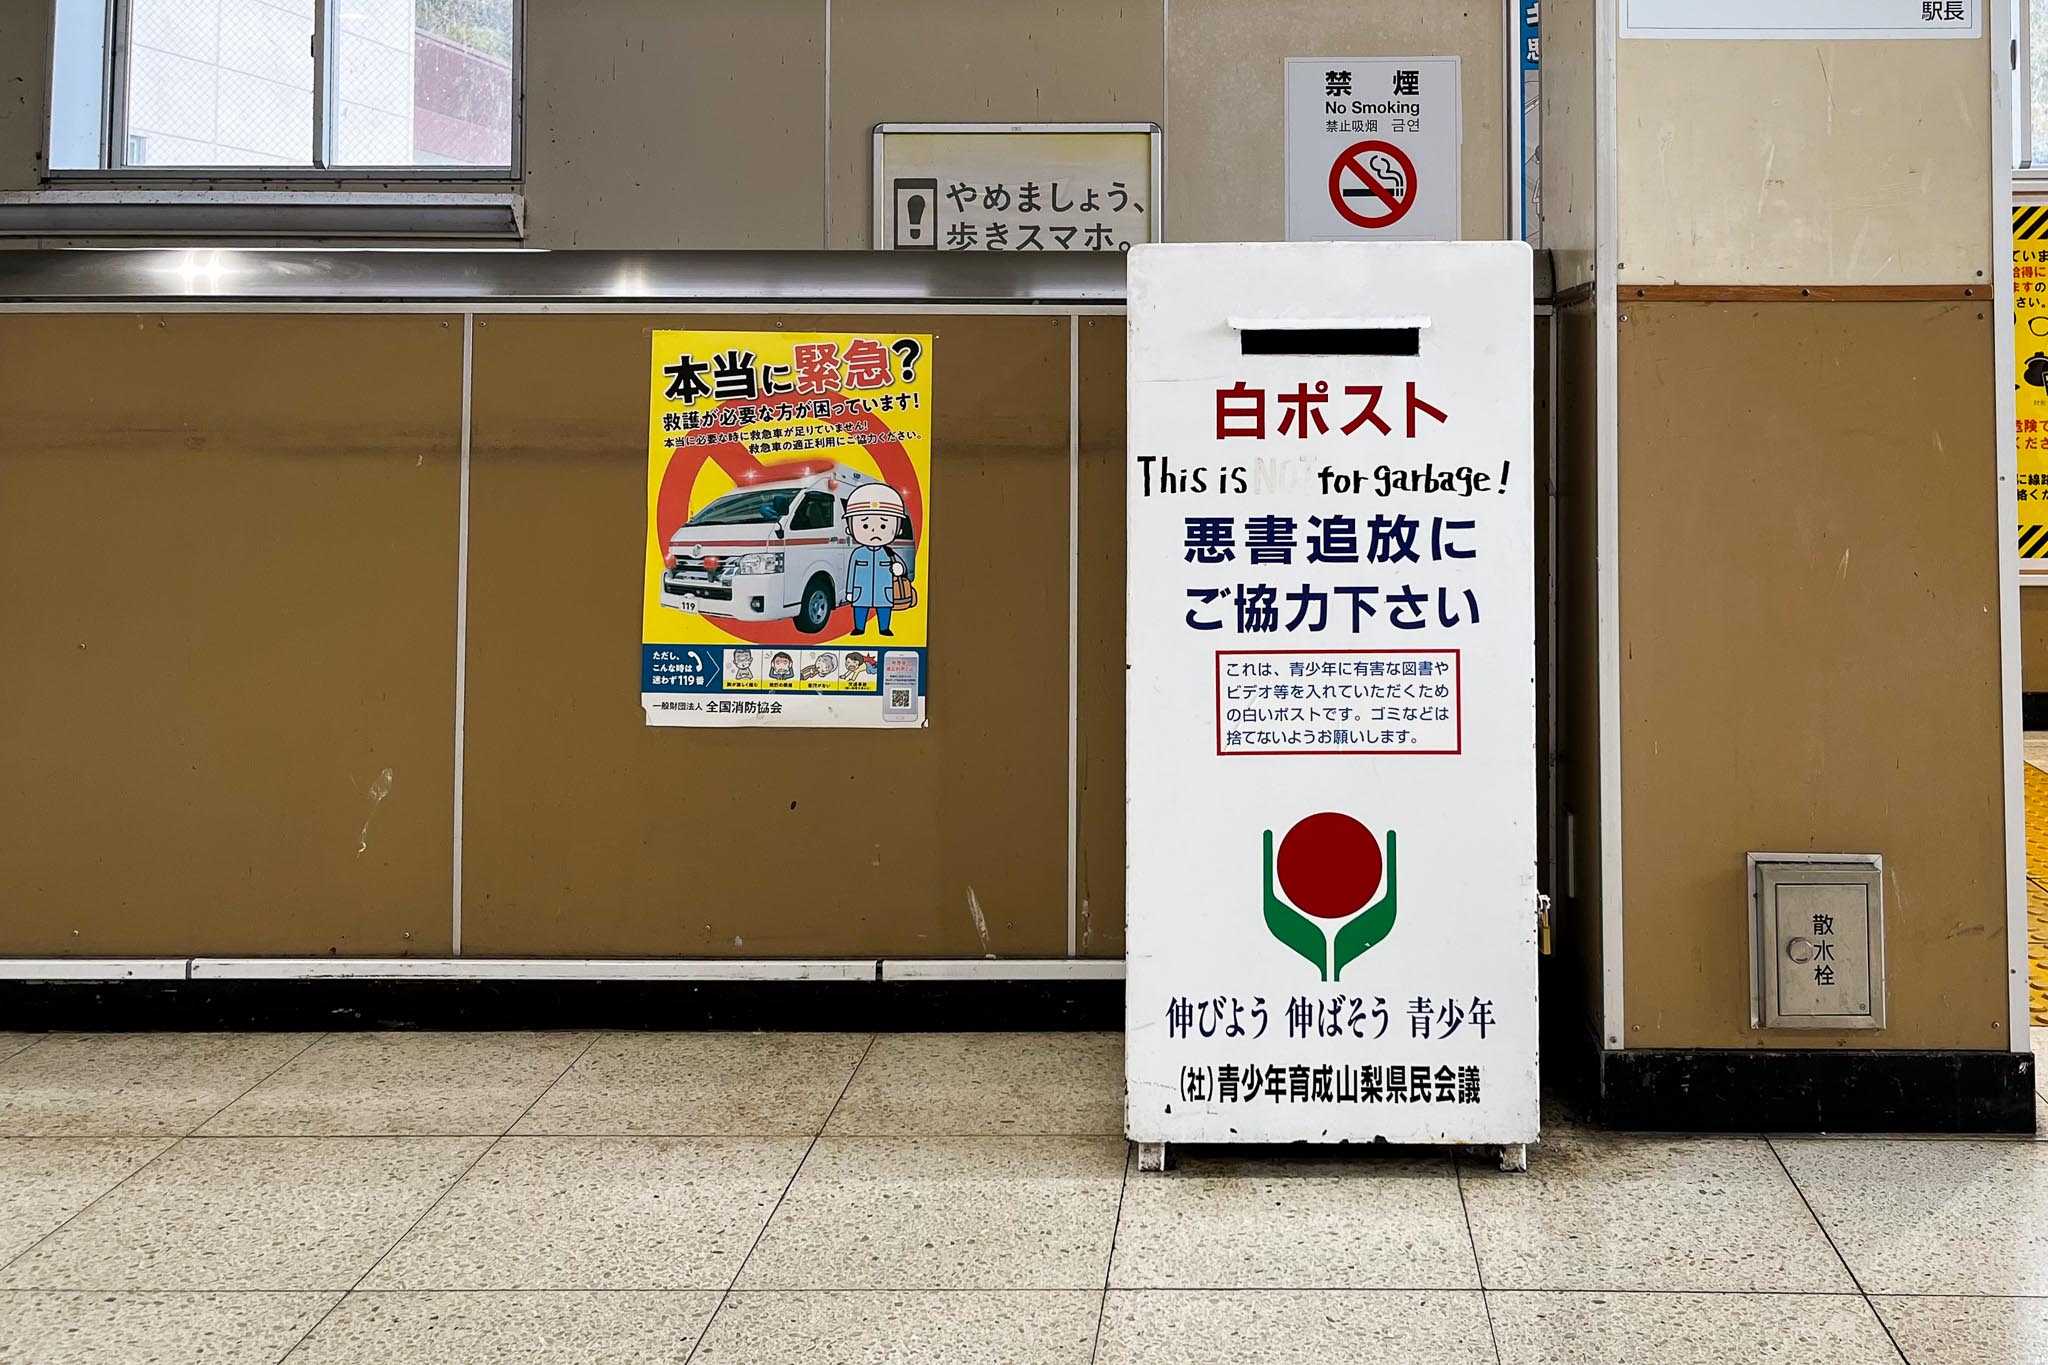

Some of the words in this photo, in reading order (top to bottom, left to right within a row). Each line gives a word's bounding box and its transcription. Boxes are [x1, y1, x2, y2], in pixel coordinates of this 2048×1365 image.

[1921, 0, 1965, 21] 駅長
[1325, 101, 1347, 115] No
[1351, 100, 1420, 117] Smoking
[1325, 119, 1378, 133] 禁止吸烟
[1391, 118, 1420, 133] 금연
[945, 181, 1145, 214] やめましょう、
[946, 221, 1131, 250] 歩きスマホ。
[1216, 380, 1448, 440] 白ポスト
[1137, 455, 1208, 497] This
[1219, 466, 1248, 494] is
[1317, 465, 1369, 495] for
[1183, 513, 1477, 565] 悪書追放に
[681, 601, 696, 611] 119
[1185, 583, 1480, 634] ご協力下さい
[652, 663, 693, 673] こんな時は
[1226, 660, 1449, 677] これは、青少年に有害な図書や
[1226, 683, 1449, 700] ビデオ等を入れていただくため
[652, 701, 703, 711] 一般財団法人
[705, 700, 783, 714] 全国消防協会
[1226, 706, 1449, 723] の白いポストです。ゴミなどは
[1226, 729, 1418, 746] 捨てないようお願いします。
[1812, 913, 1835, 986] 散水栓
[1165, 995, 1268, 1039] 伸びよう
[1284, 994, 1389, 1040] 伸ばそう
[1406, 996, 1496, 1040] 青少年
